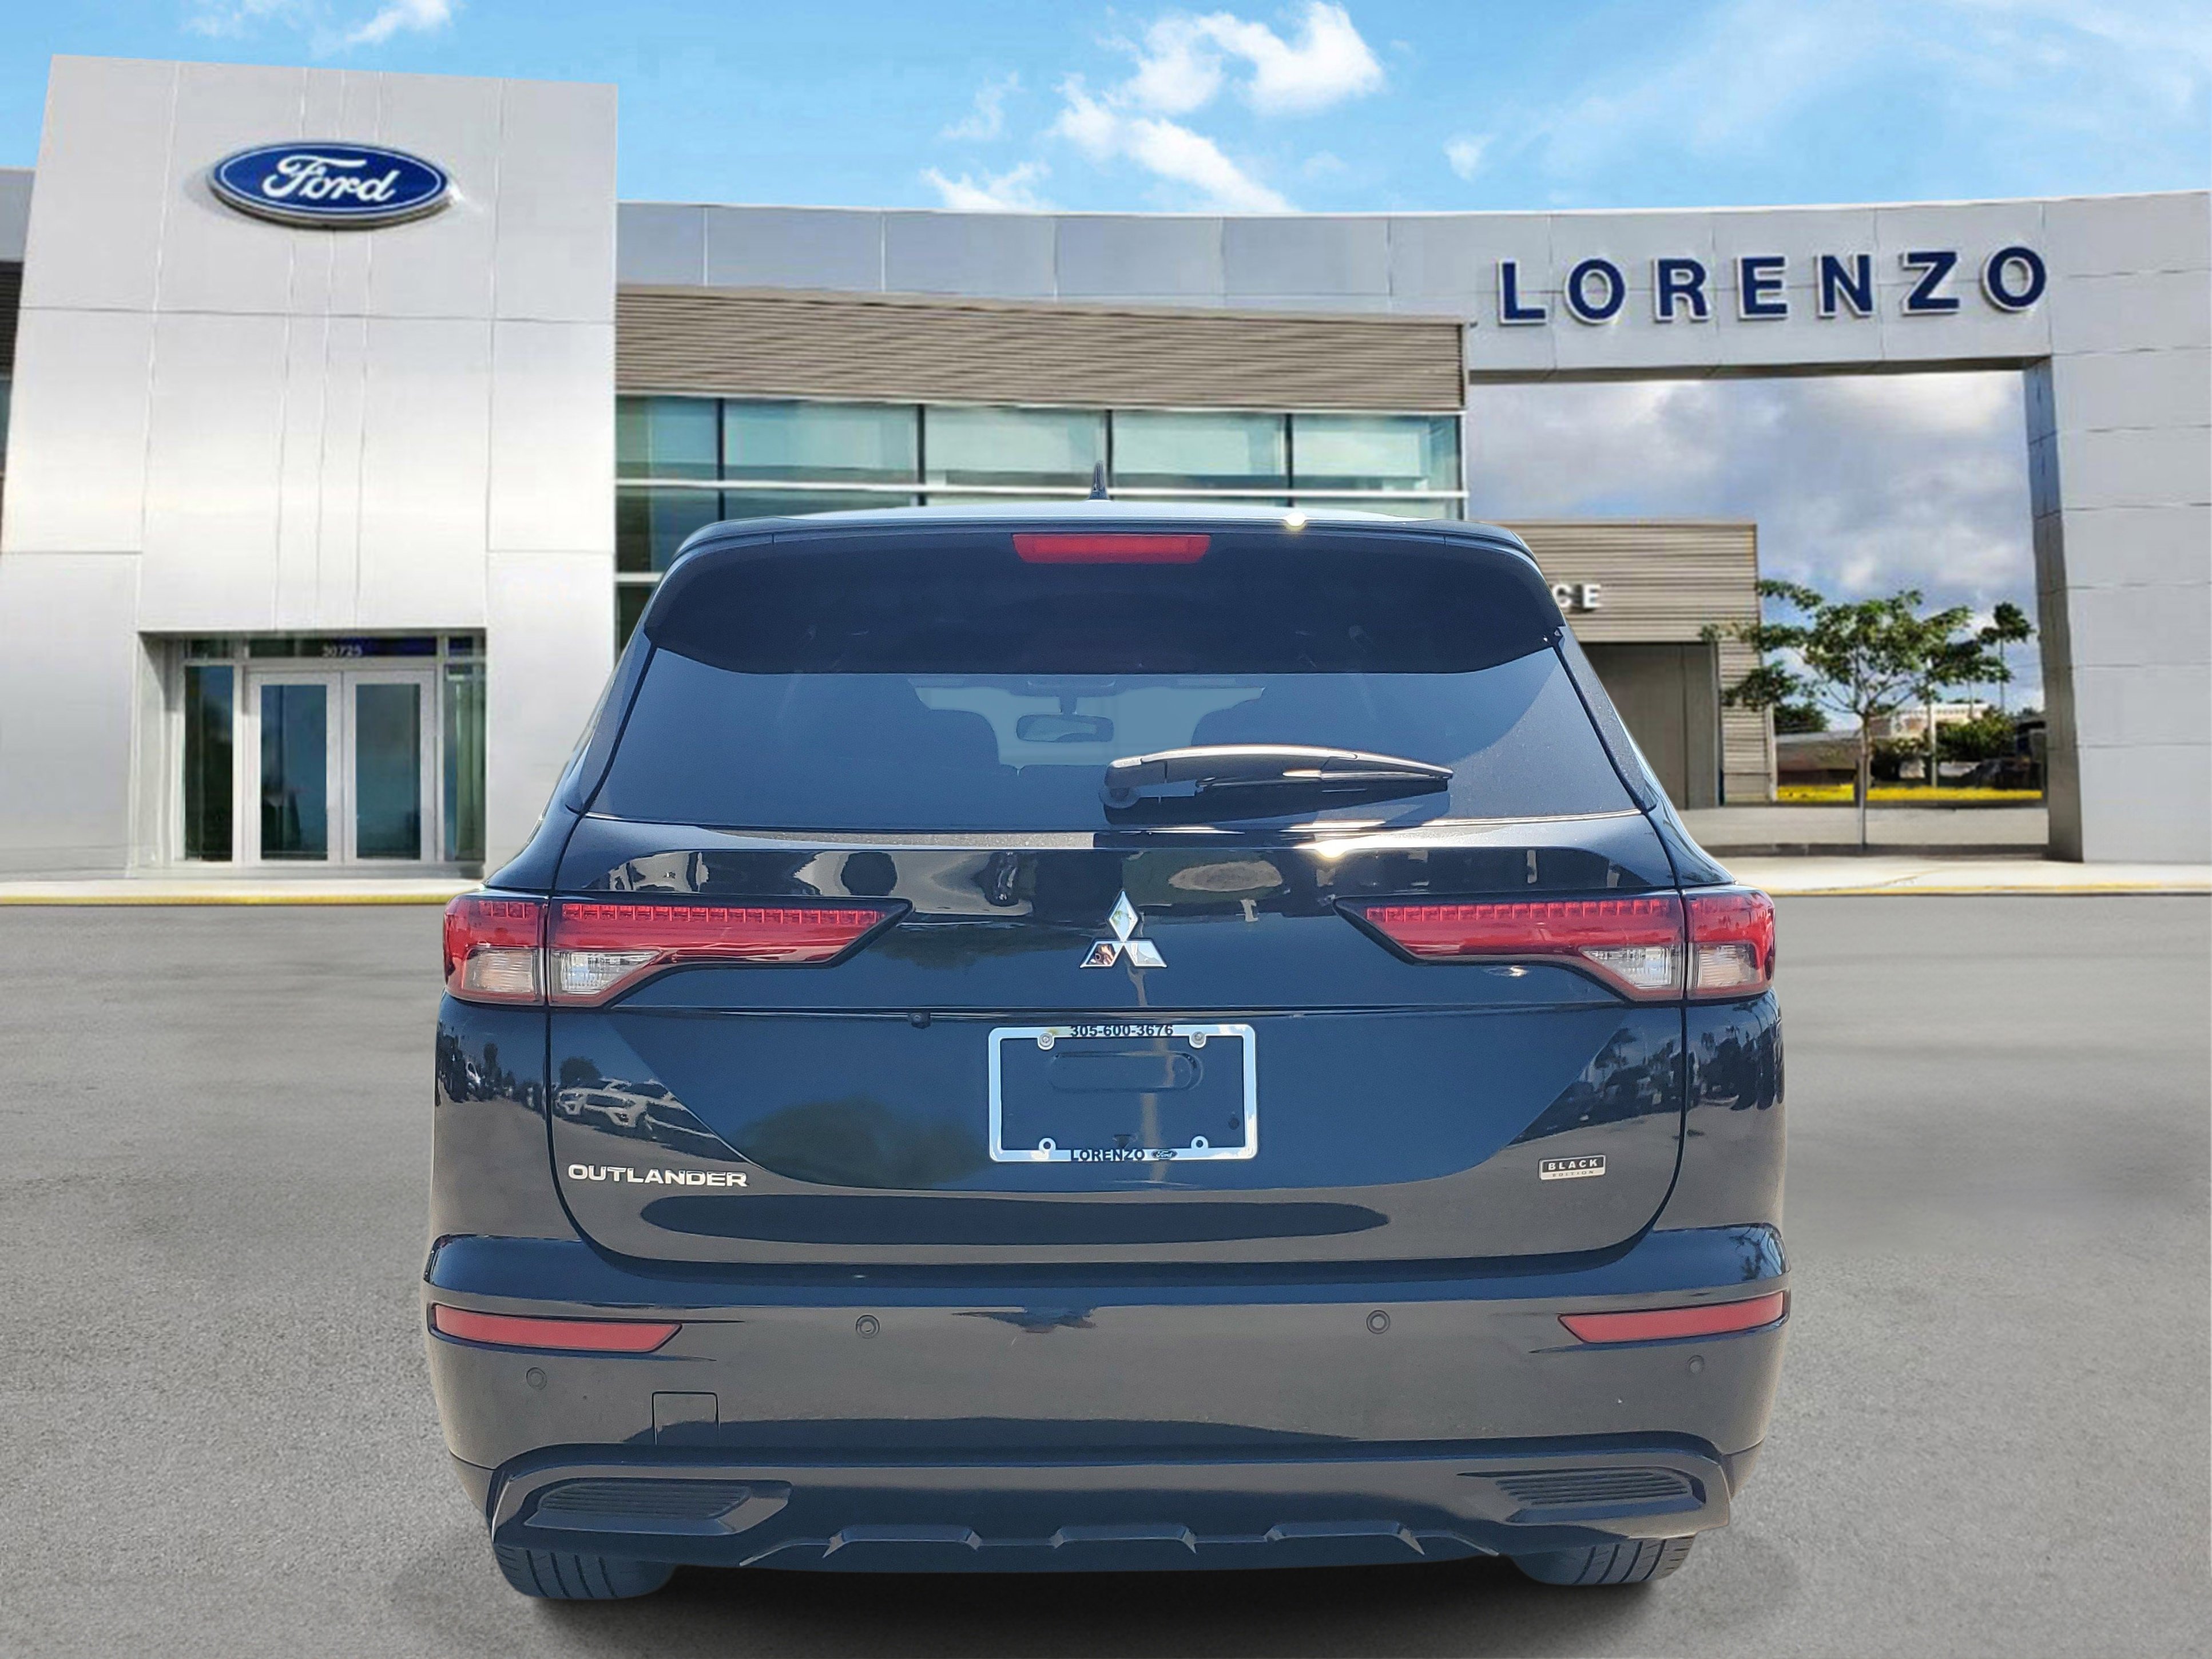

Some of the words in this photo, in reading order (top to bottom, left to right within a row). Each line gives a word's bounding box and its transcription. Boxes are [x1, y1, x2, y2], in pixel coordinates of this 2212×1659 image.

[261, 153, 401, 202] Ford
[1498, 245, 2047, 324] LORENZO
[1070, 1024, 1174, 1037] 305-600-3676
[1070, 1149, 1145, 1162] LORENZO
[1548, 1158, 1598, 1170] BLACK
[567, 1164, 748, 1188] OUTLANDER
